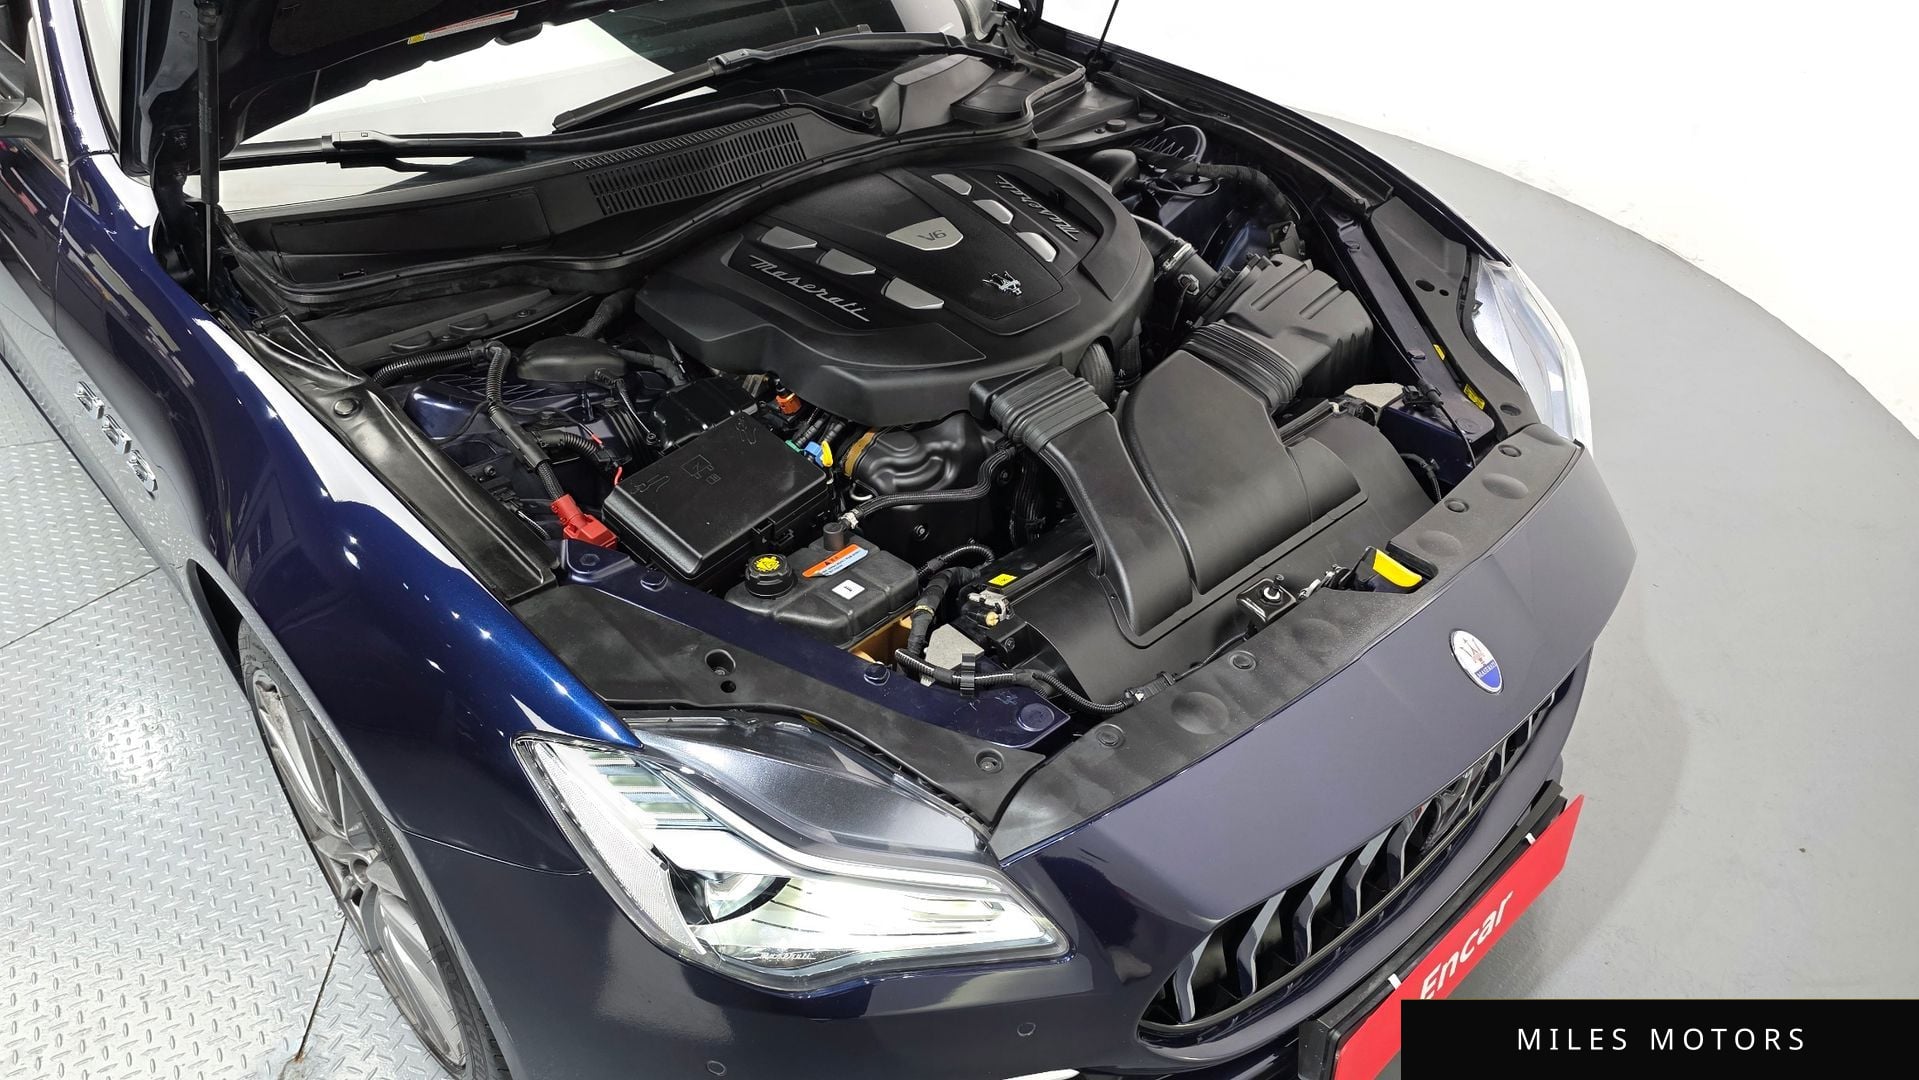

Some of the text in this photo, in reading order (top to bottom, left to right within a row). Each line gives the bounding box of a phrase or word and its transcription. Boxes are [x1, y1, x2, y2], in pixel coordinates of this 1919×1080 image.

[916, 230, 947, 241] V6
[995, 174, 1079, 241] Maserati
[749, 254, 870, 322] Maserati
[1420, 890, 1513, 1000] Encar
